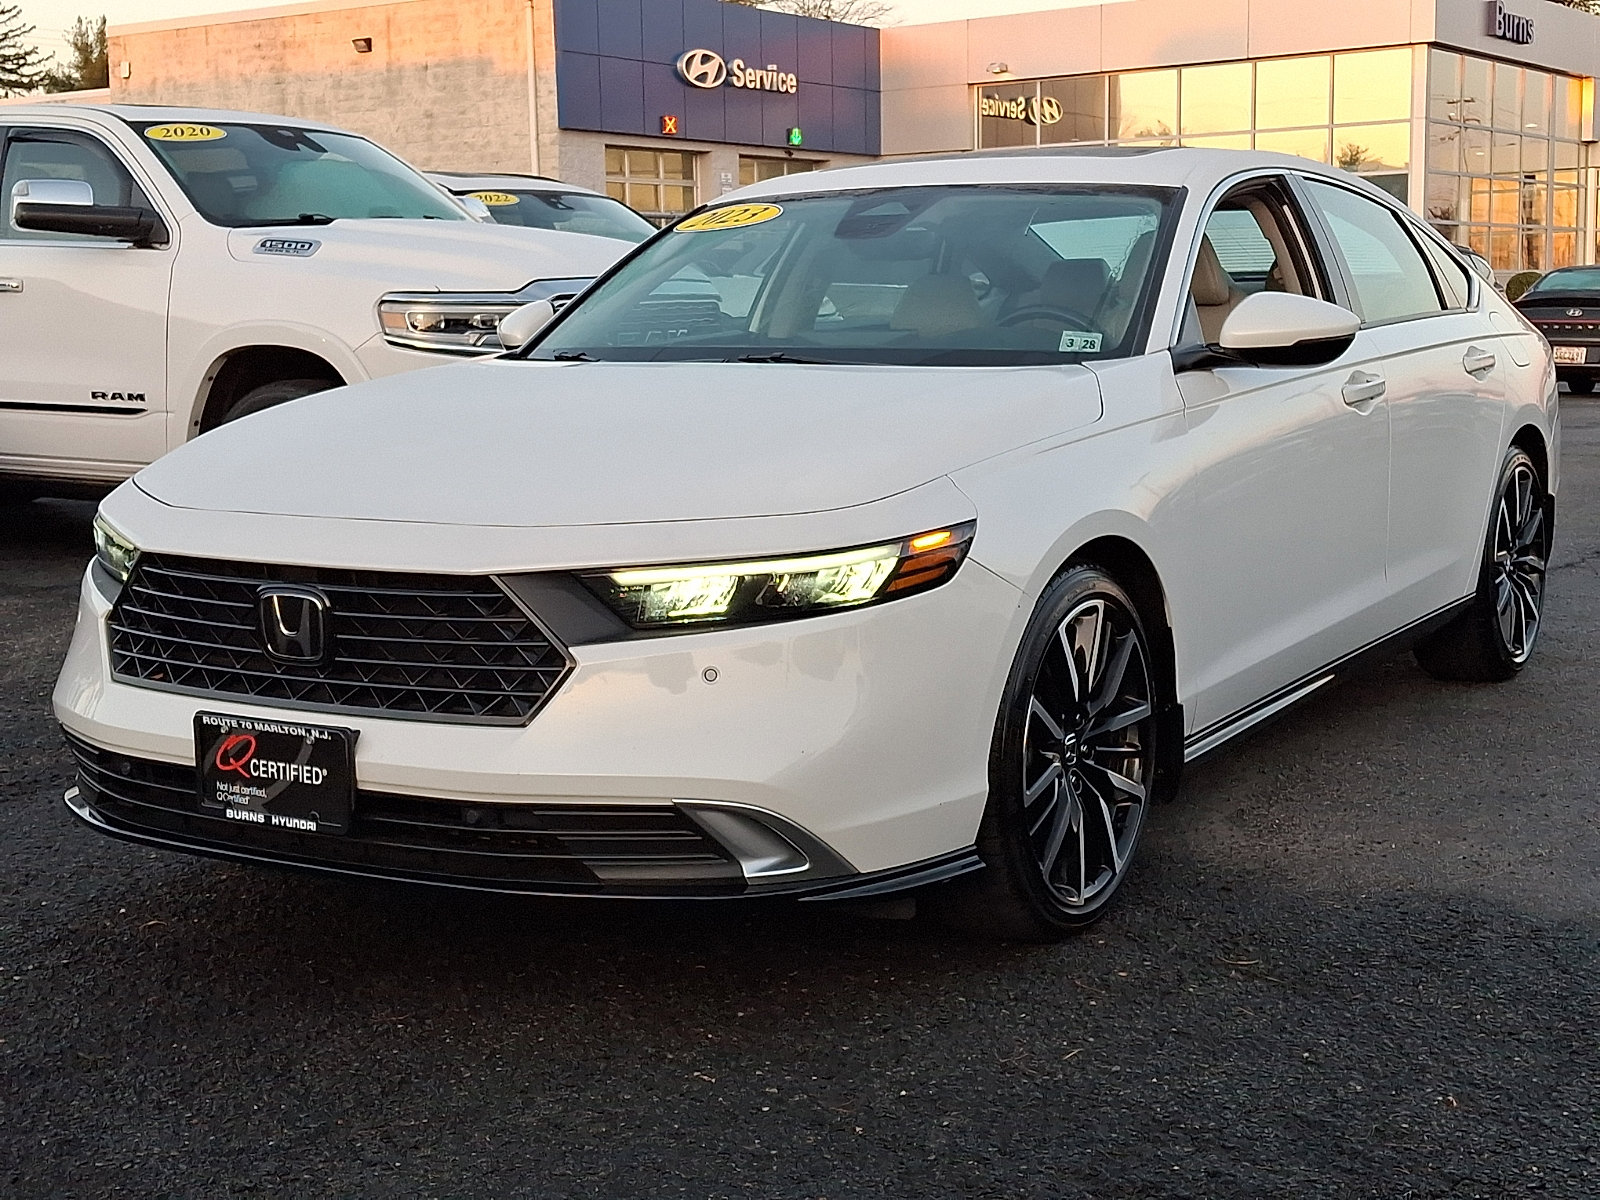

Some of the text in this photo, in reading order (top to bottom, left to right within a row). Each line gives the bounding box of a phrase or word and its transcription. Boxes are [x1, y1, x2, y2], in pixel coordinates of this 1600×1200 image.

[1495, 0, 1535, 44] Burns
[731, 58, 797, 94] Service
[160, 126, 211, 138] 2020
[683, 206, 771, 229] 2023
[261, 240, 311, 250] 1500
[1066, 338, 1096, 350] 3 28
[90, 391, 146, 402] RAM
[202, 716, 332, 741] ROUTE 70 MARLTON, N.J.
[216, 734, 256, 778] Q
[216, 780, 228, 791] Not
[229, 783, 240, 794] just
[225, 808, 317, 831] BURNS HYUNDAI
